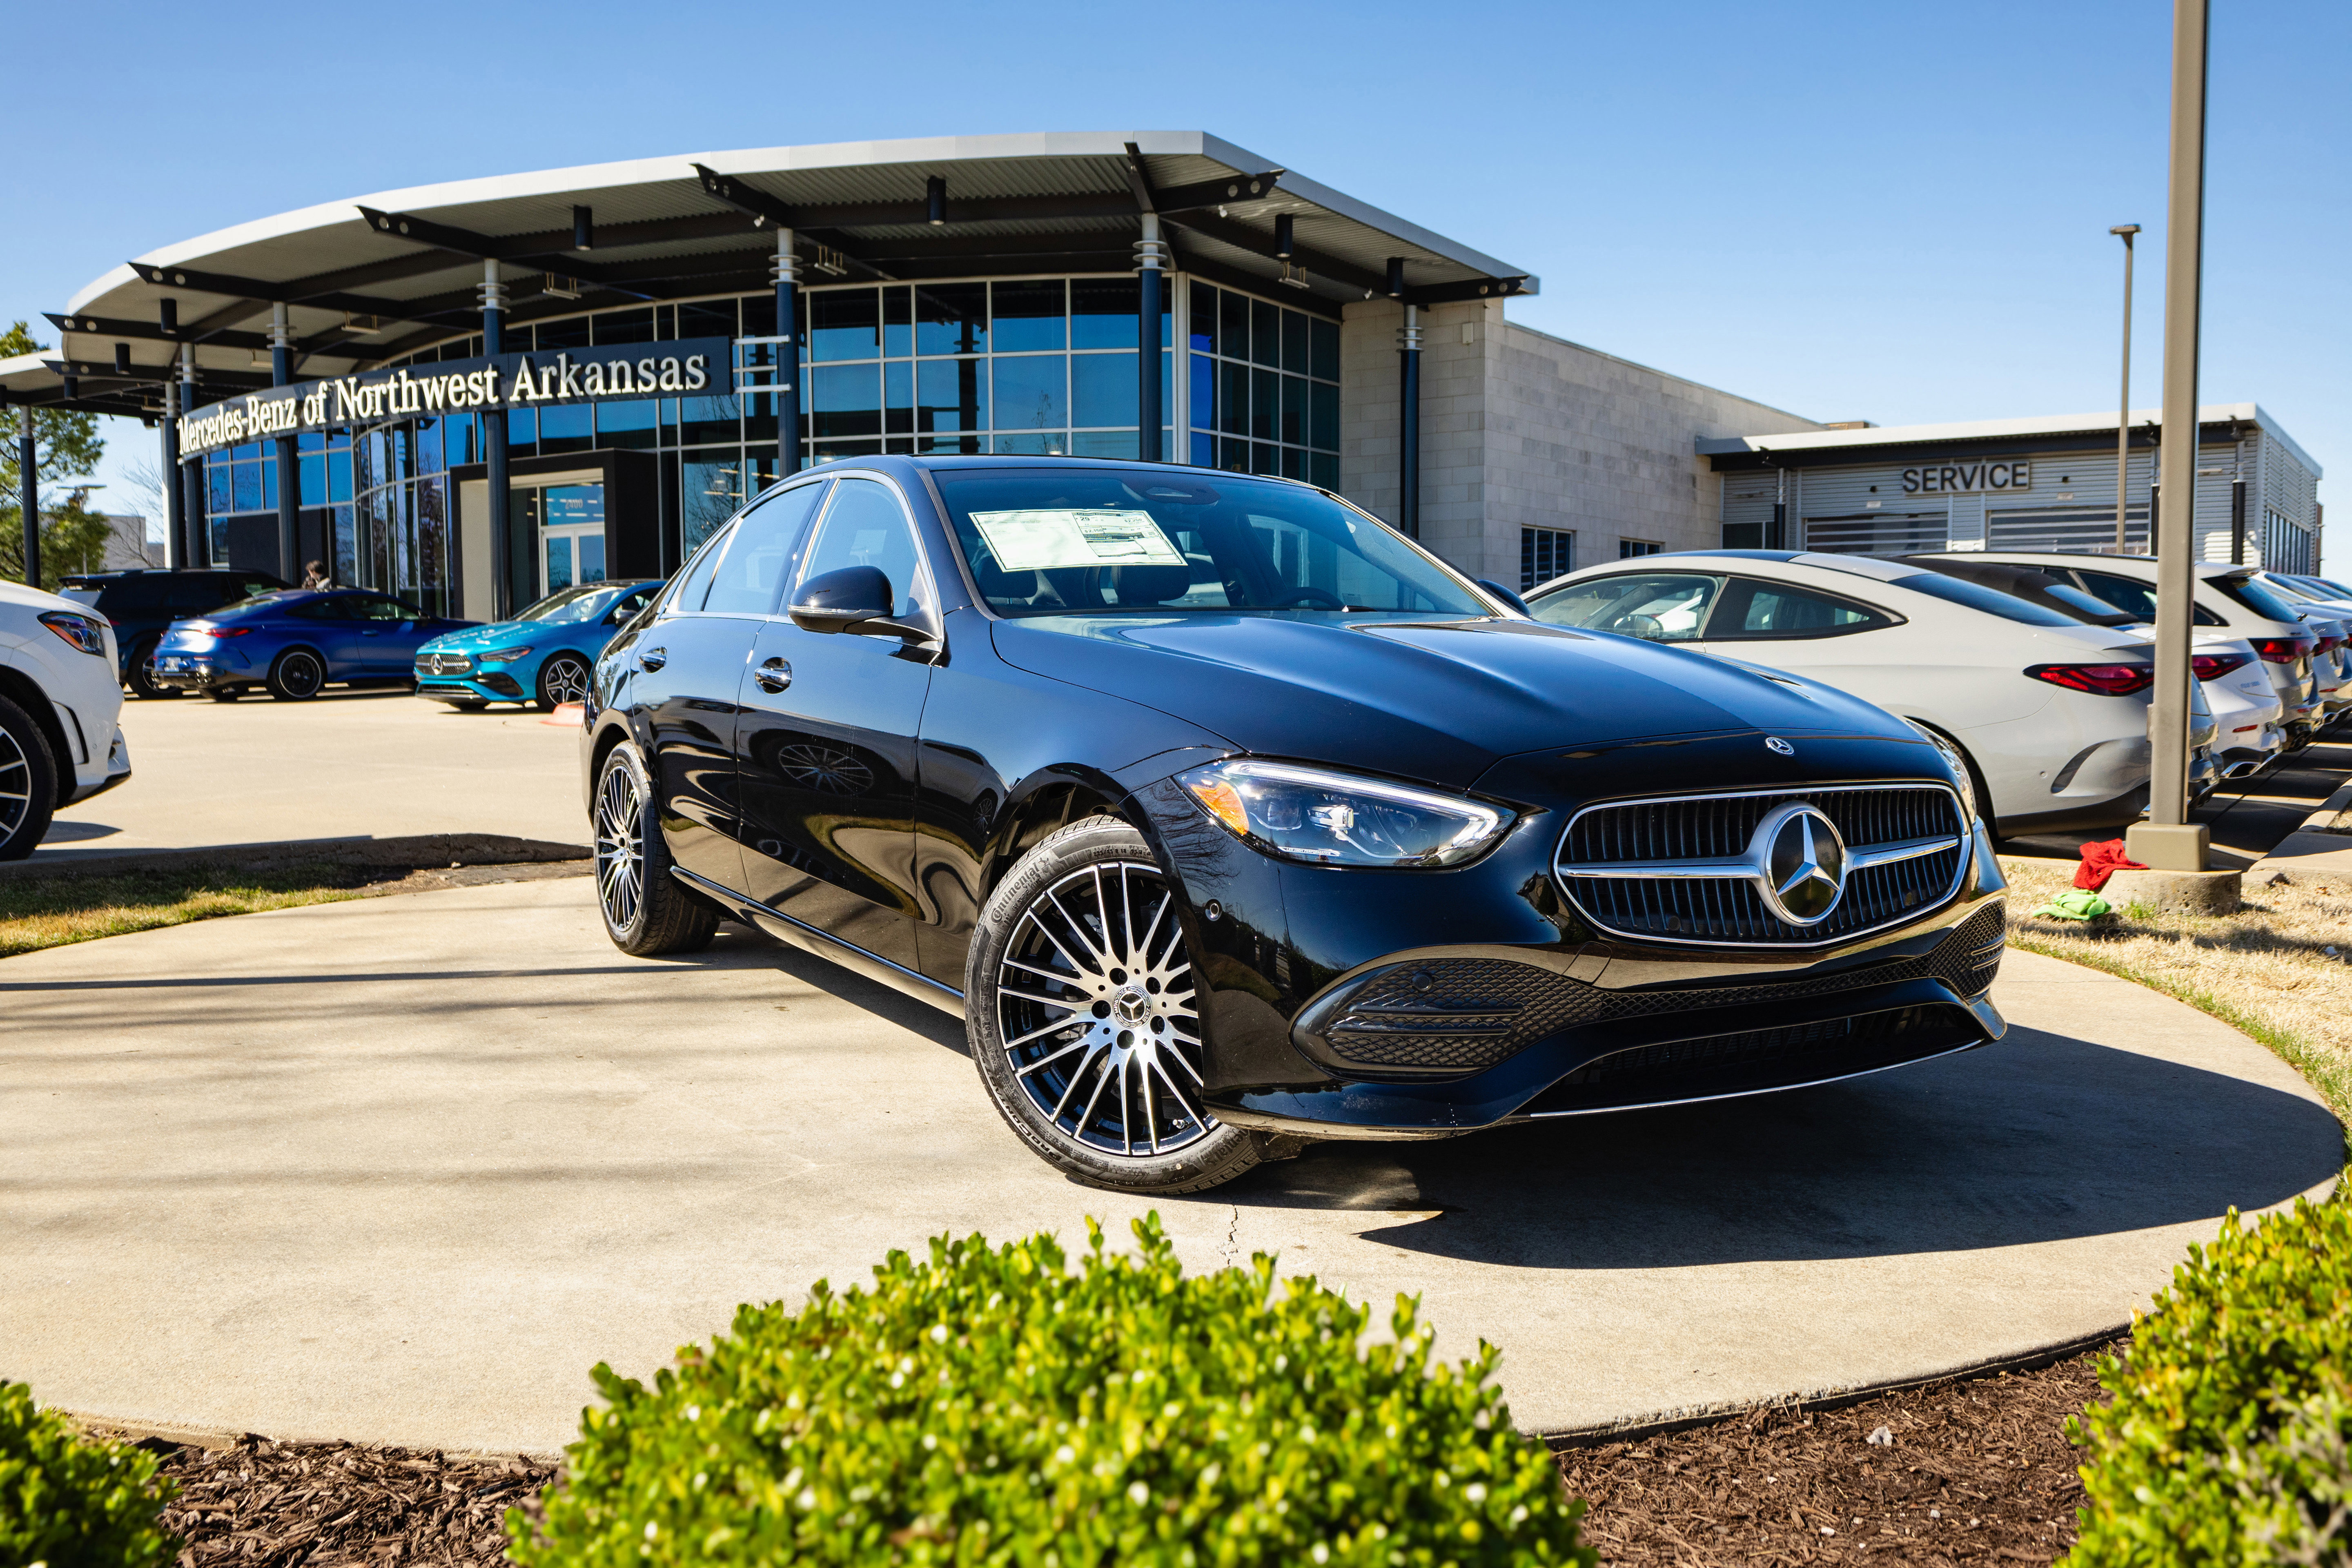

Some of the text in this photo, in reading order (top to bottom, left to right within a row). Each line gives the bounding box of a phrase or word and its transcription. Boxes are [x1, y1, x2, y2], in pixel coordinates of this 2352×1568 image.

[178, 353, 706, 454] Mercedes-Benz of Northwest Arkansas
[1902, 463, 2028, 493] SERVICE
[991, 862, 1040, 924] Continental
[1114, 987, 1151, 1022] MERCEDES BENZ
[984, 1066, 1062, 1161] PROCONTACT
